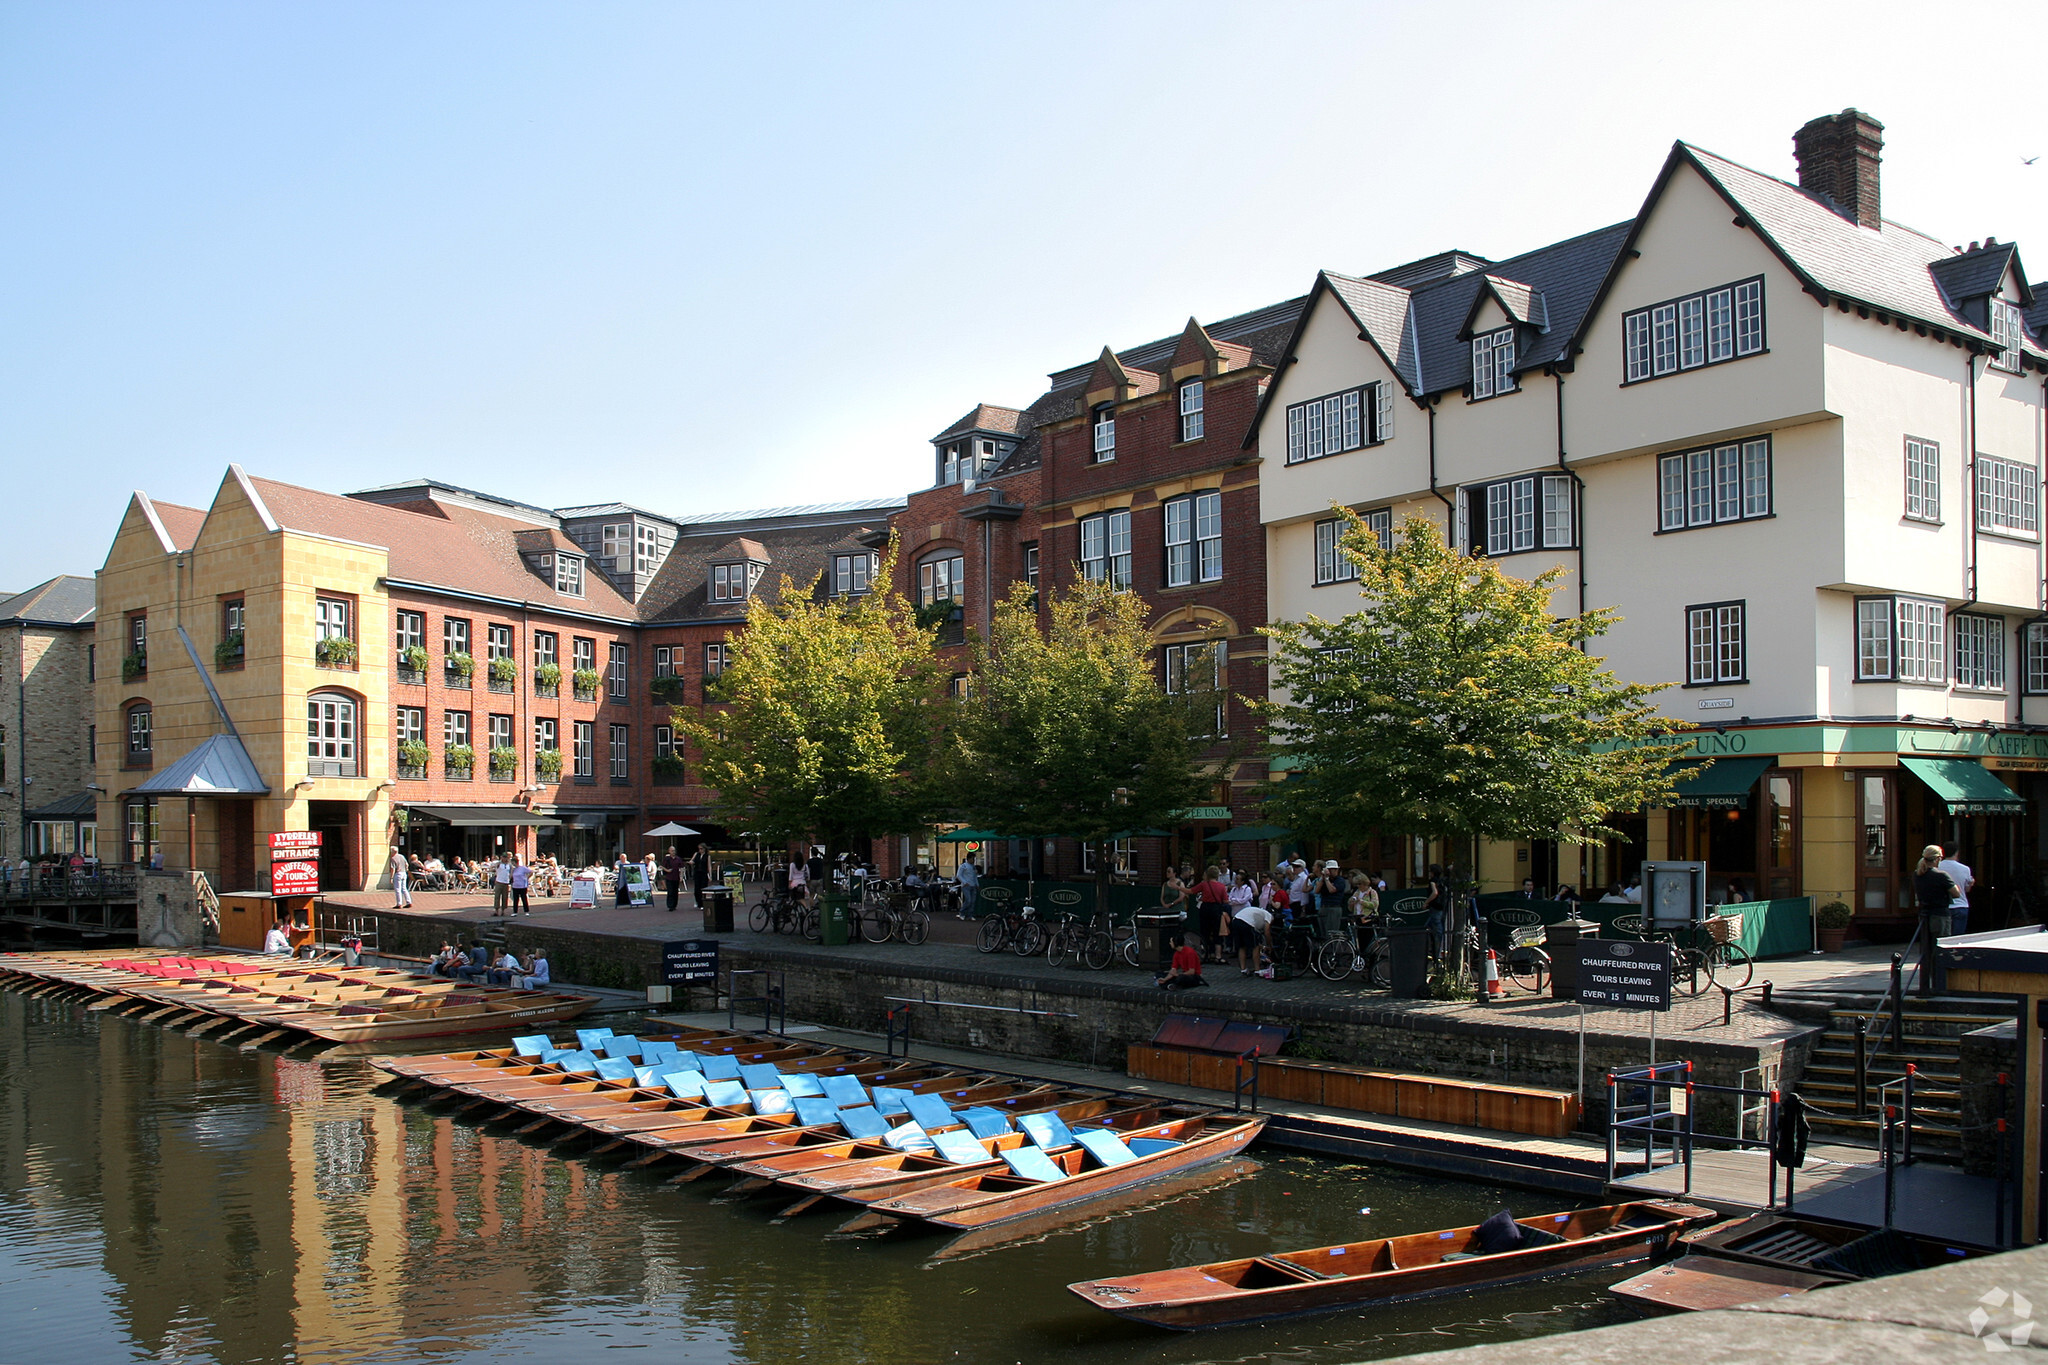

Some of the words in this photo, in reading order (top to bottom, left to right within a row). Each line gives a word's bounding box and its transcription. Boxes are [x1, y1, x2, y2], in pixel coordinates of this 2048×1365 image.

[1694, 733, 1746, 754] UNO
[1987, 735, 2029, 755] CAFFÉ
[1204, 808, 1225, 818] UNO
[274, 832, 318, 841] TYRRELLS
[273, 848, 320, 858] ENTRANCE
[273, 861, 319, 881] CHAUFFEURED
[285, 872, 309, 881] TOURS
[1582, 958, 1638, 969] CHAUFFEURED
[1638, 962, 1662, 971] RIVER
[1592, 974, 1618, 984] TOURS
[1619, 976, 1652, 986] LEAVING
[1582, 989, 1606, 999] EVERY
[1626, 993, 1660, 1003] MINUTES
